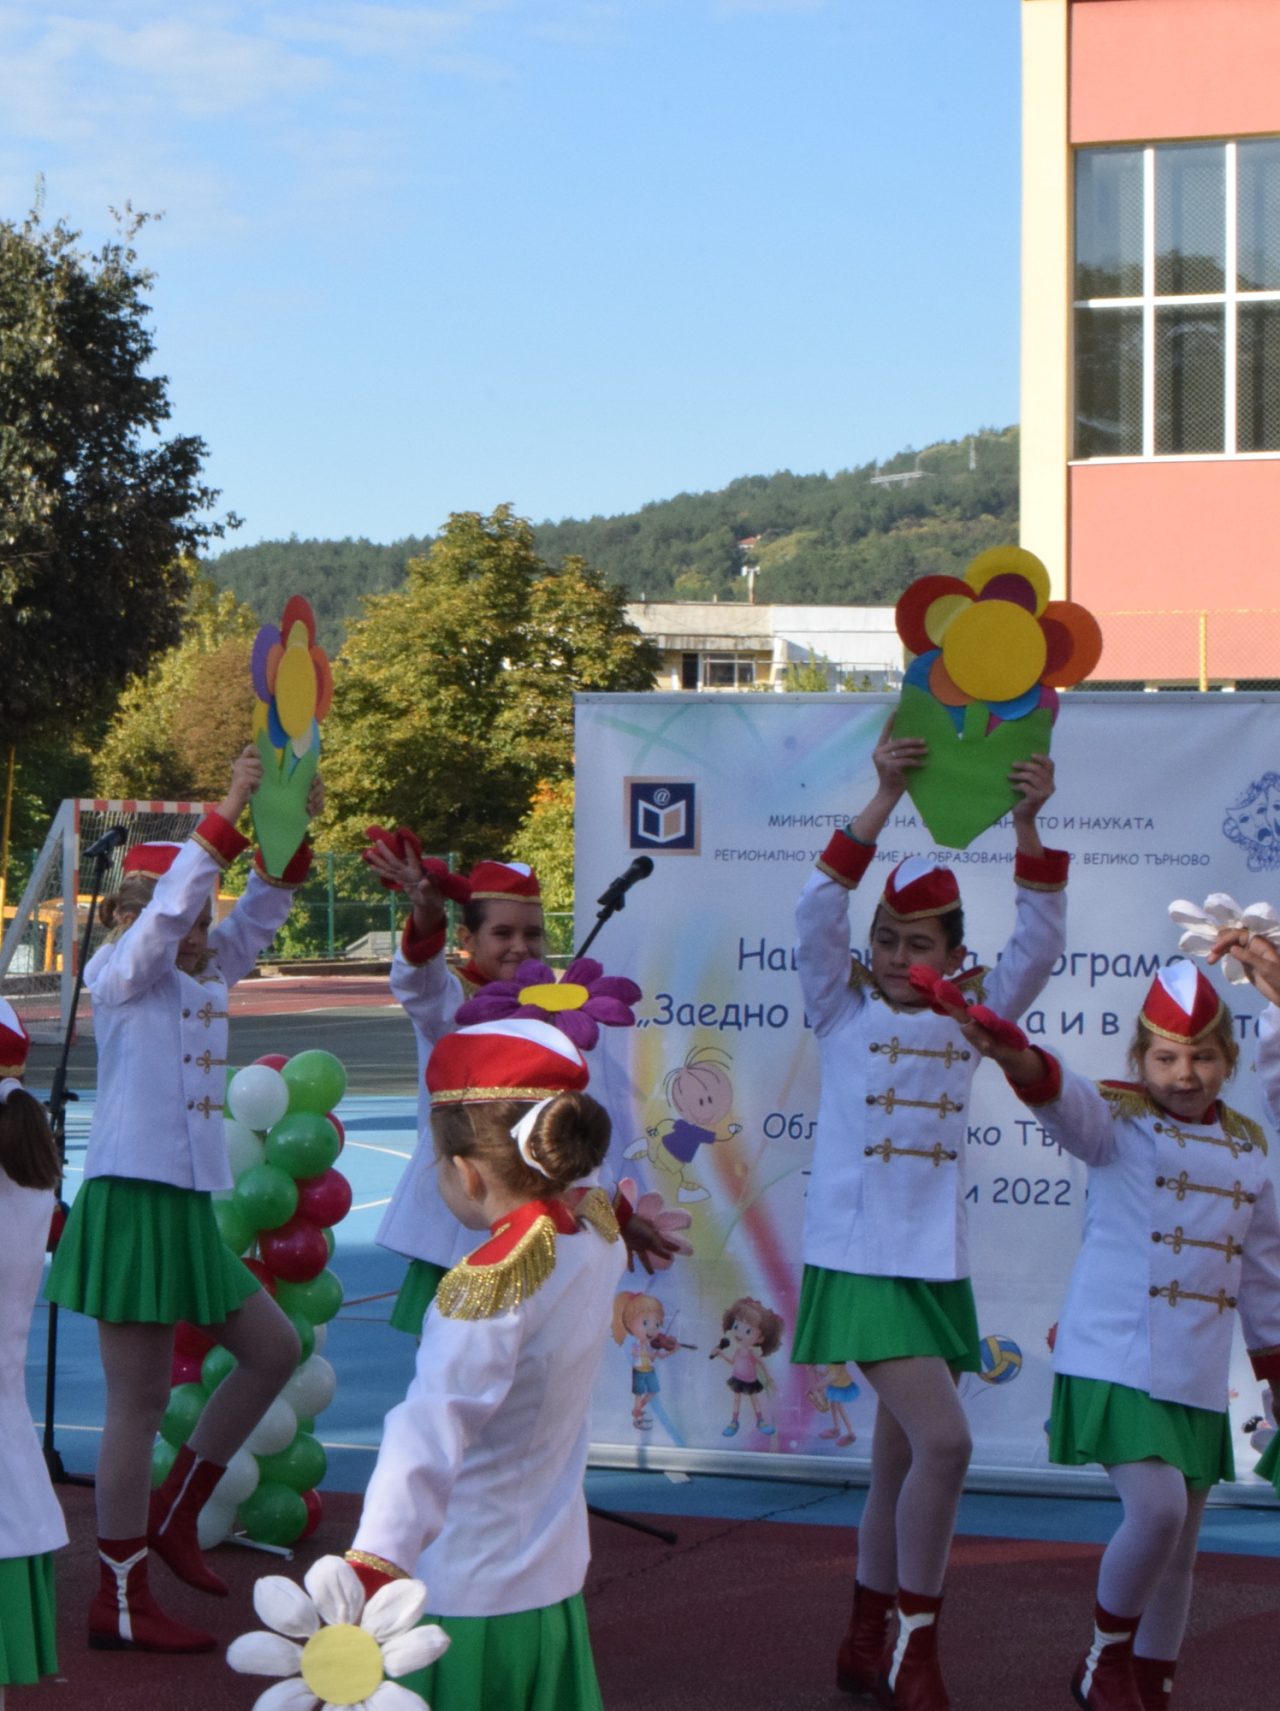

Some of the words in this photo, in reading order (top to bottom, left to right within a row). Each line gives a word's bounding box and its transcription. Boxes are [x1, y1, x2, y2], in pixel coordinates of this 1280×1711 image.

[895, 816, 917, 828] НА
[1063, 817, 1075, 829] И
[1079, 817, 1154, 830] НАУКАТА
[715, 850, 806, 862] РЕГИОНАЛНО
[1083, 853, 1140, 865] ВЕЛИКО
[1145, 854, 1210, 867] ТЪРНОВО
[1061, 1011, 1084, 1036] и
[1101, 1012, 1120, 1036] в
[992, 1177, 1071, 1206] 2022
